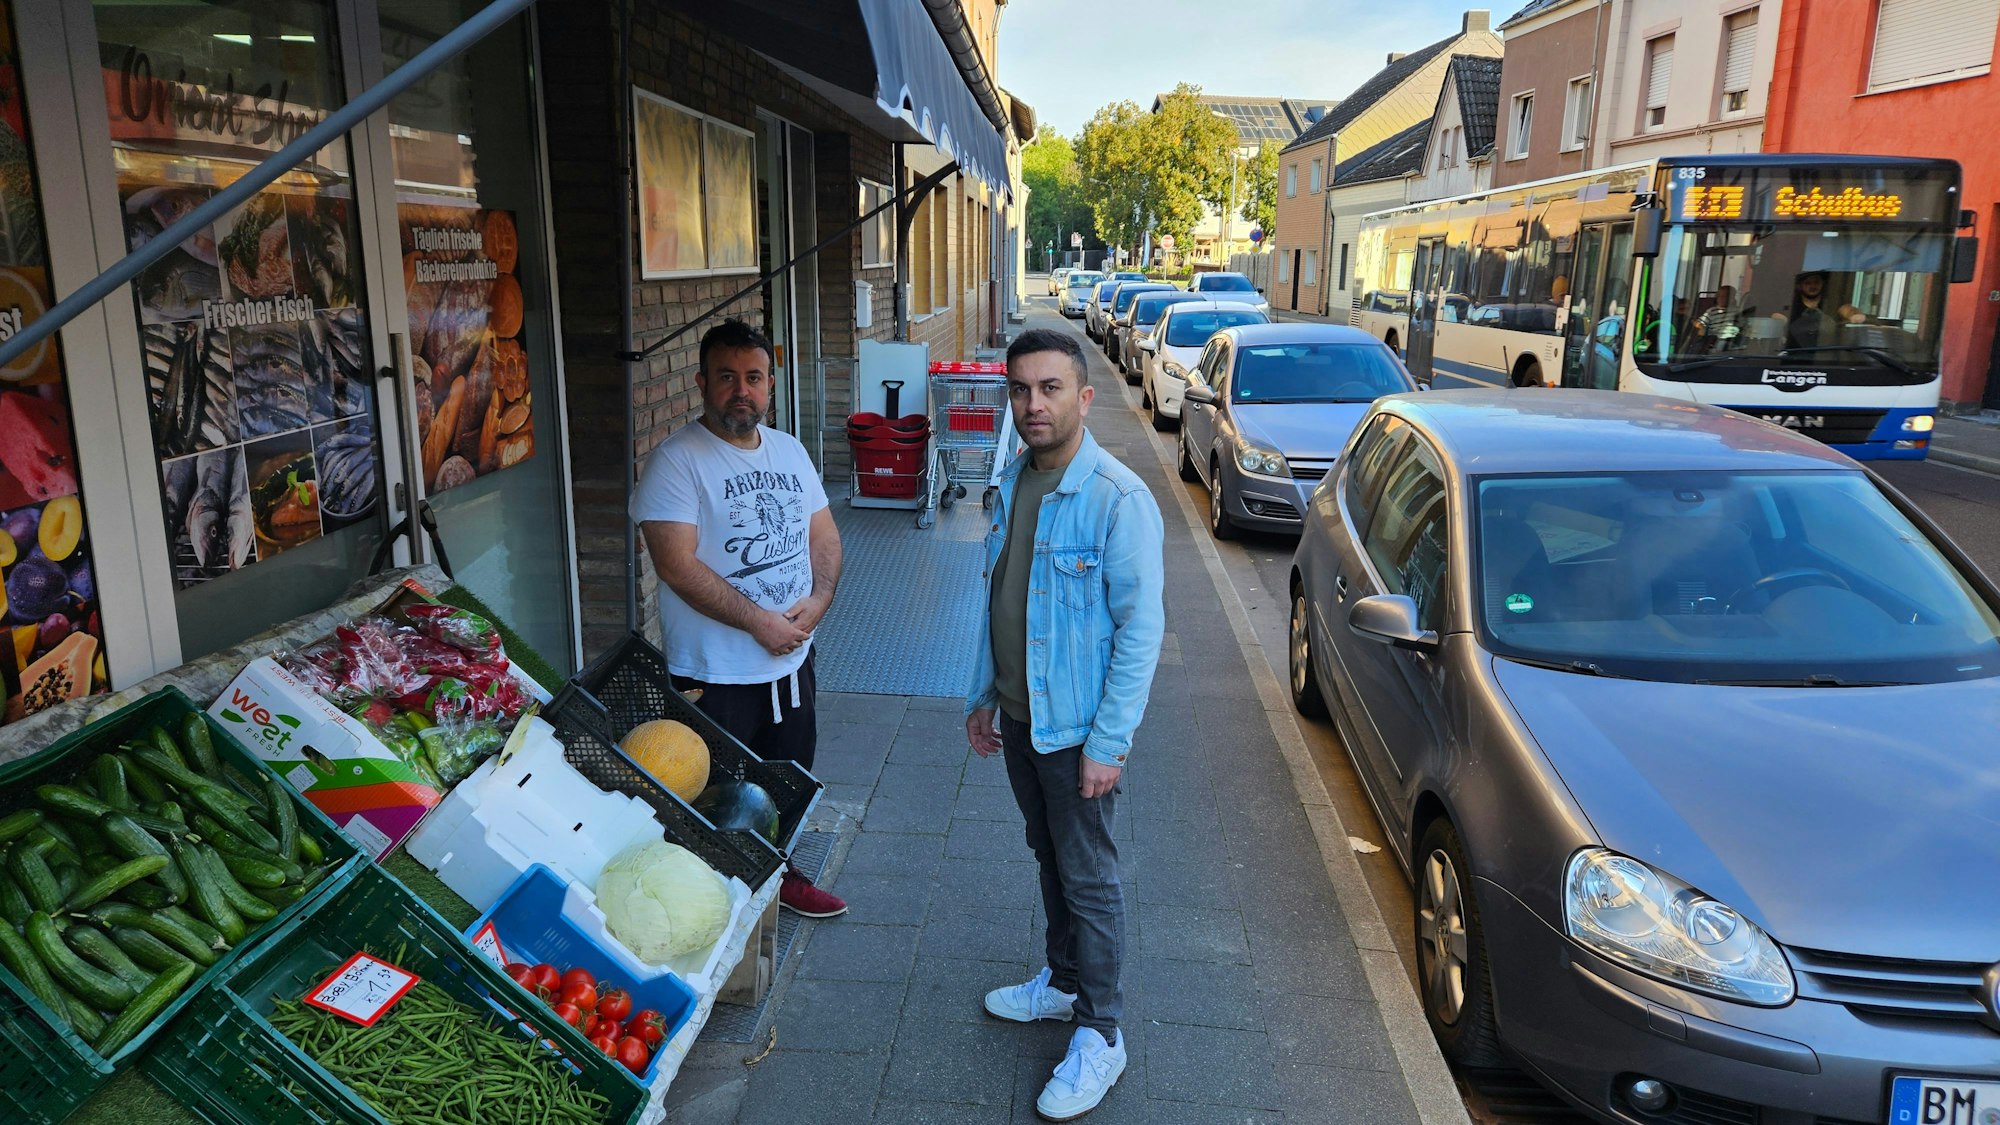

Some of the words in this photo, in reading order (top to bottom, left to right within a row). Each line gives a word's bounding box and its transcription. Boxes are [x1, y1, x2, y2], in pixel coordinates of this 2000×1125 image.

[1678, 167, 1706, 179] 835
[1774, 186, 1902, 217] Schulbus
[412, 227, 450, 252] Täglich
[450, 228, 483, 250] frische
[415, 259, 498, 282] Bäckereiprodukte
[202, 298, 272, 329] Frischer
[274, 294, 315, 322] Fisch
[1761, 369, 1827, 386] Langen
[874, 467, 893, 475] REWE
[723, 470, 803, 499] ARIZONA
[729, 511, 740, 520] EST
[271, 666, 296, 686] WEST
[323, 706, 347, 724] BEST
[245, 727, 281, 757] FRESH
[1900, 1109, 1912, 1121] D
[1922, 1087, 1976, 1125] BM
